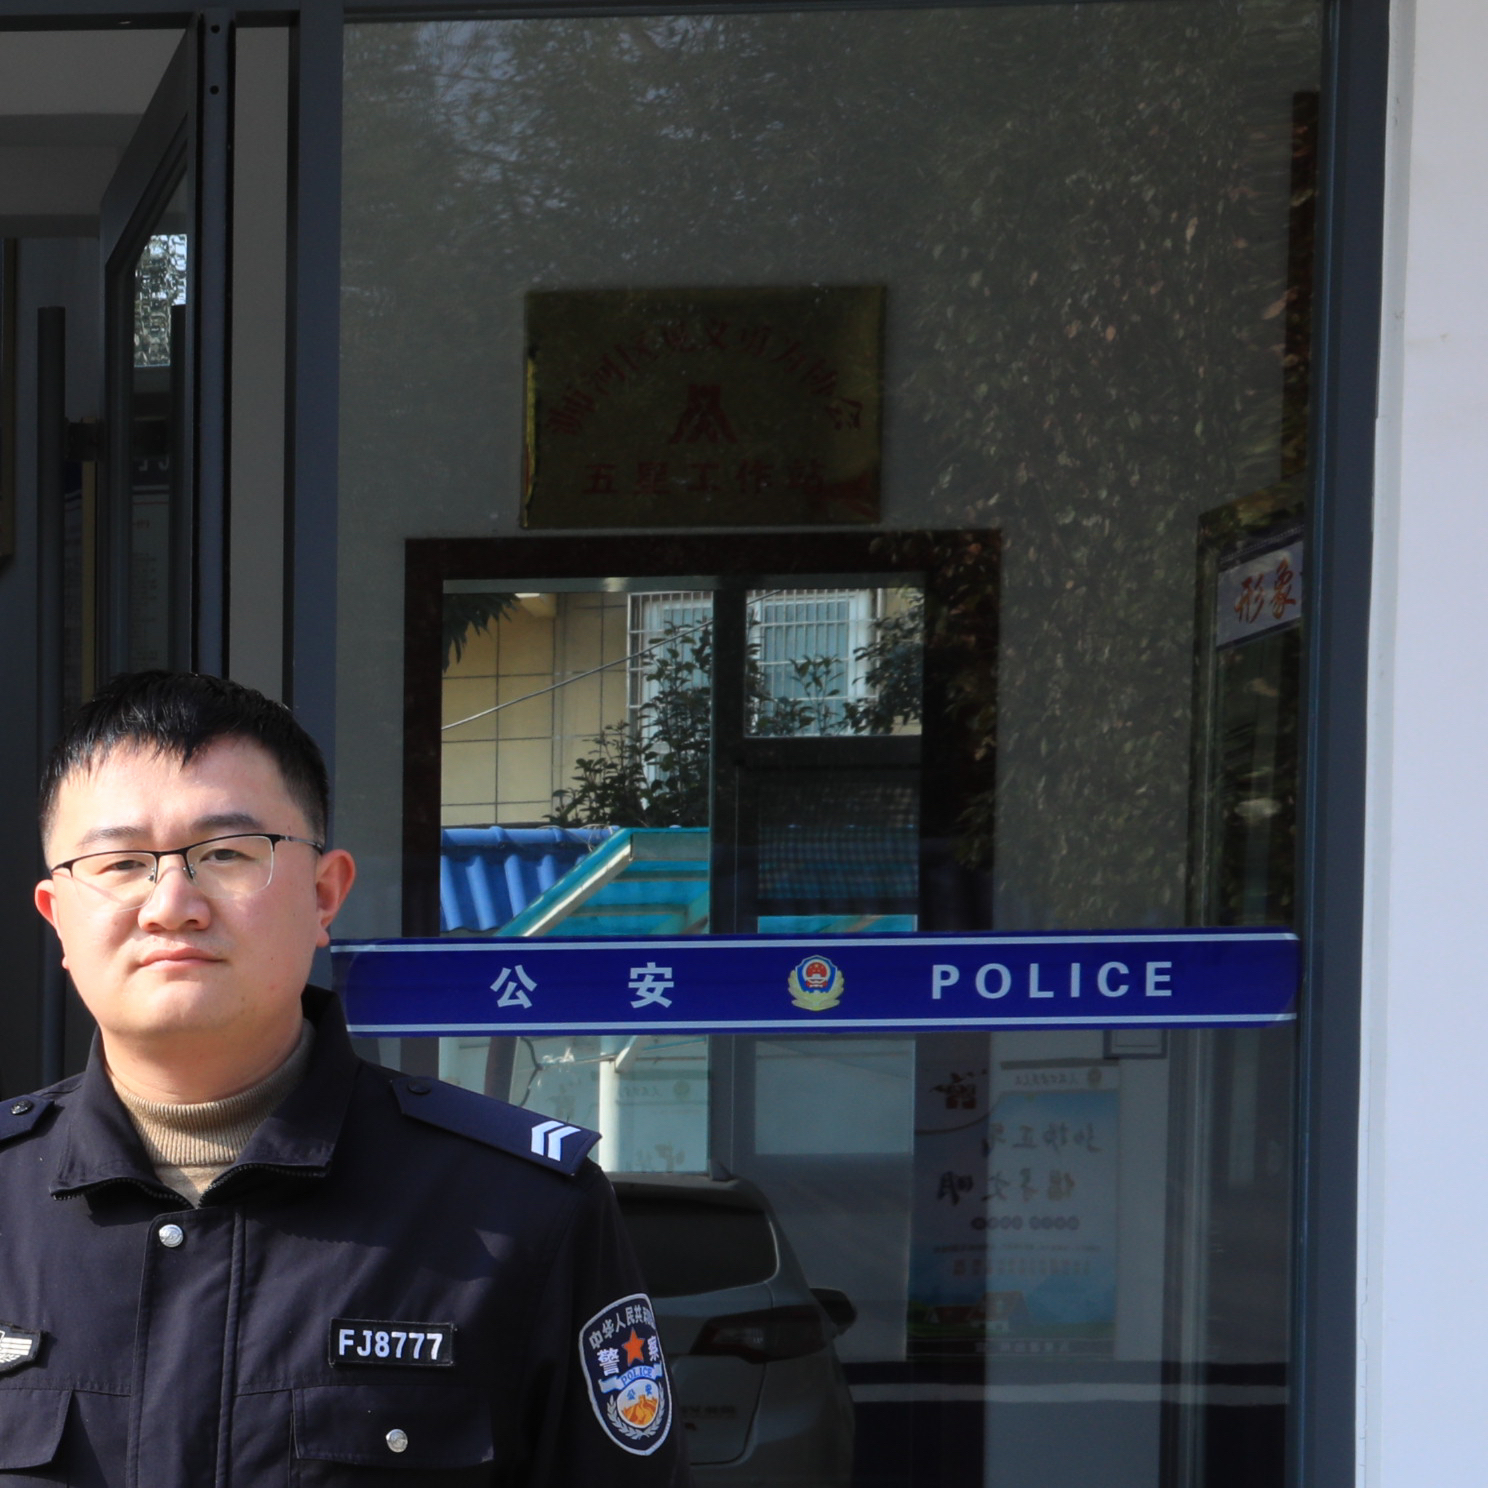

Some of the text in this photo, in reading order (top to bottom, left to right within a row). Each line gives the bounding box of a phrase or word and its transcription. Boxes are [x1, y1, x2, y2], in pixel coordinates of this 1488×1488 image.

[490, 962, 1173, 1009] 公安 POLICE
[339, 1329, 444, 1360] FJ8777
[620, 1366, 654, 1386] POLICE
